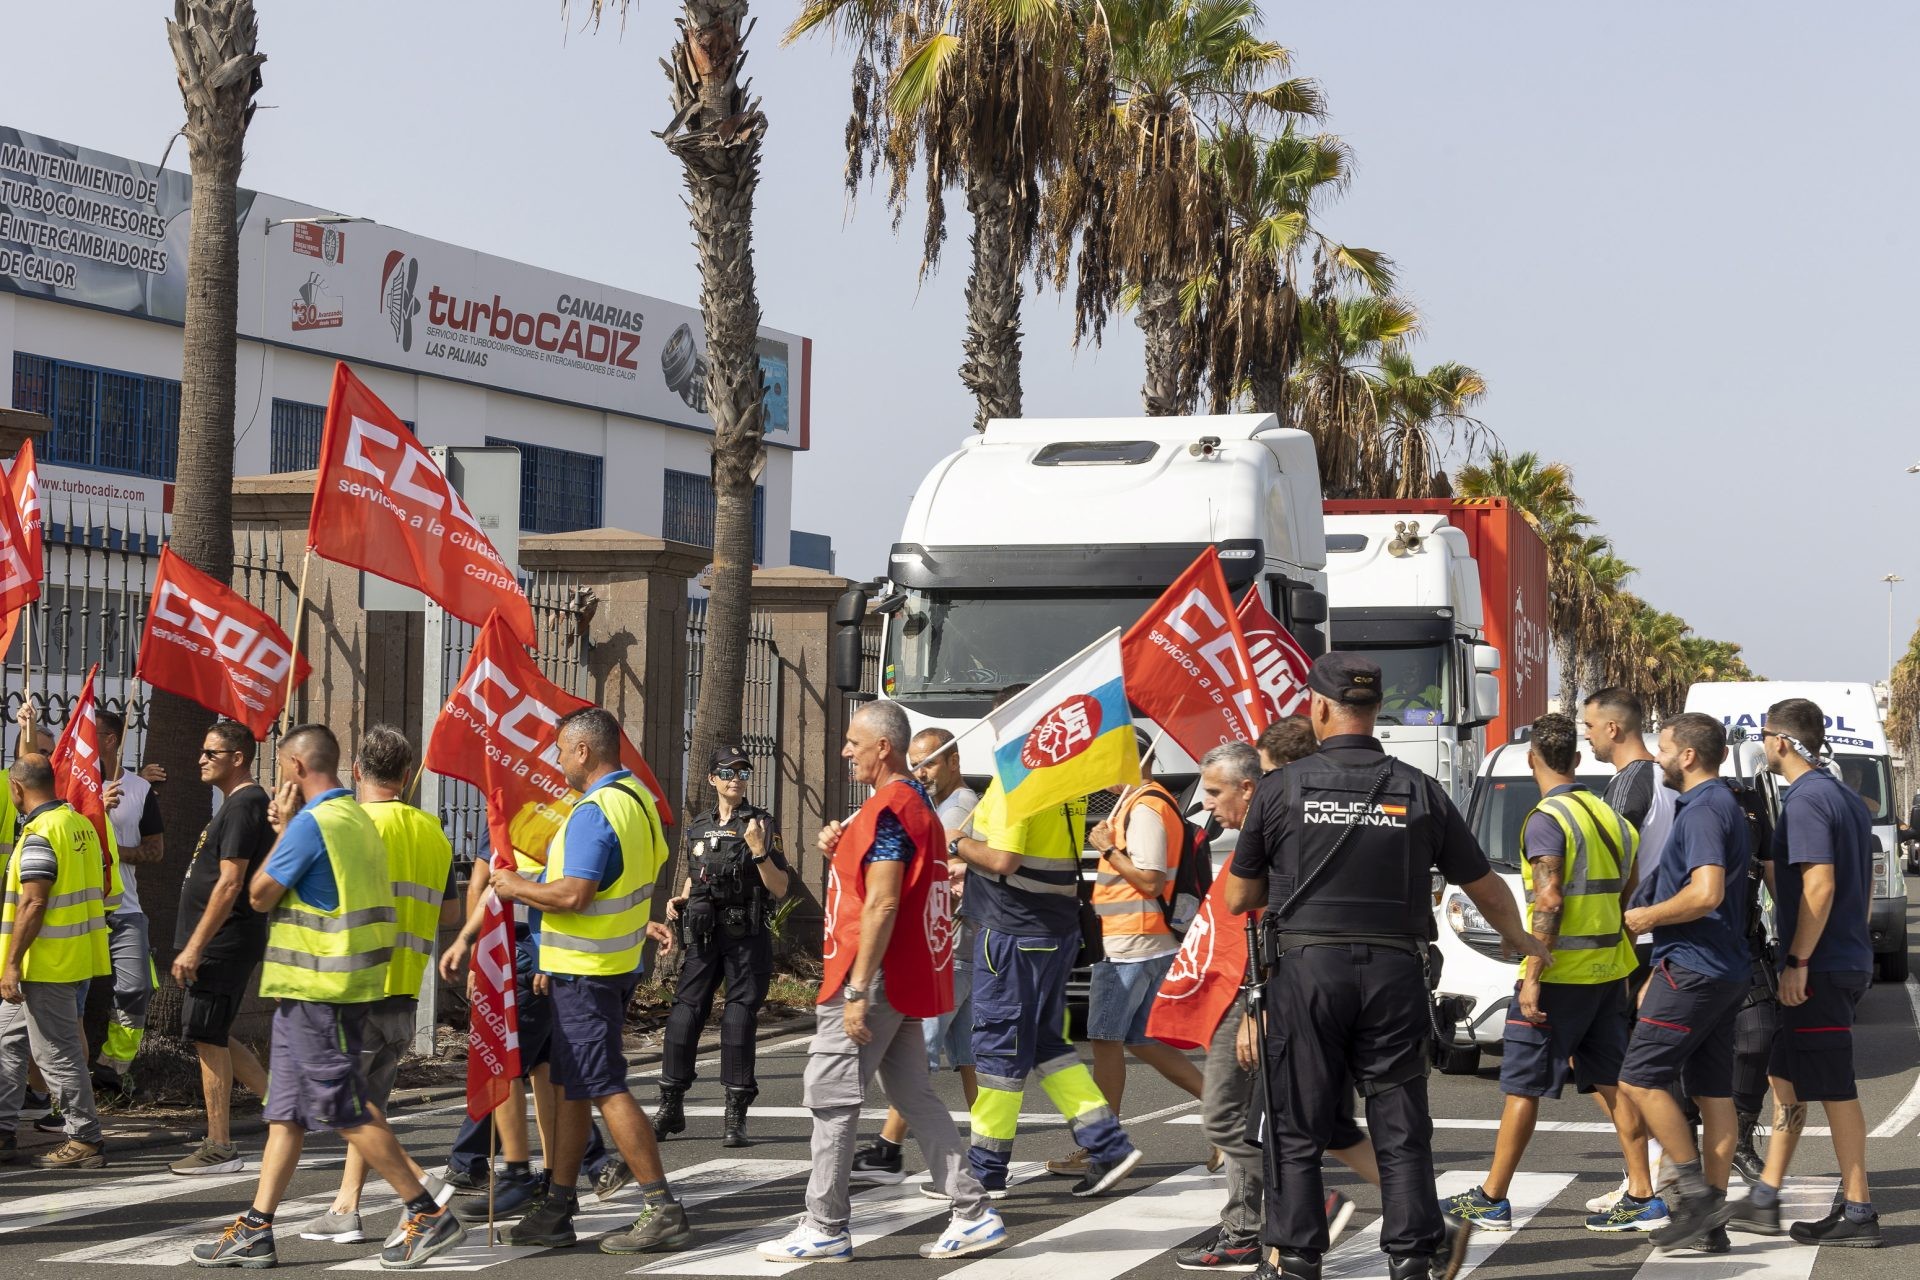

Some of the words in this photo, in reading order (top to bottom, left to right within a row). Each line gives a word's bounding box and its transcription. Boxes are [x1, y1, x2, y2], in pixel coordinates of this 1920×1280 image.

[1, 145, 134, 198] MANTENIMIENTO
[136, 179, 158, 204] DE
[1, 180, 166, 239] TURBOCOMPRESORES
[0, 214, 10, 238] E
[12, 216, 168, 272] INTERCAMBIADORES
[0, 250, 21, 275] DE
[24, 255, 76, 286] CALOR
[428, 285, 641, 371] turboCADIZ
[557, 294, 644, 332] CANARIAS
[425, 341, 446, 358] LAS
[447, 346, 489, 367] PALMAS
[426, 326, 458, 341] SERVICIO
[459, 333, 468, 344] DE
[470, 336, 540, 360] TURBOCOMPRESORES
[545, 354, 606, 375] INTERCAMBIADORES
[606, 367, 616, 377] DE
[616, 370, 637, 380] CALOR
[338, 479, 407, 521] servicios
[410, 515, 424, 529] a
[427, 517, 446, 537] la
[1148, 629, 1201, 677] servicios
[1199, 677, 1211, 688] a
[1209, 688, 1224, 704] la
[1060, 701, 1093, 746] UGT
[501, 754, 512, 767] a
[512, 758, 530, 777] la
